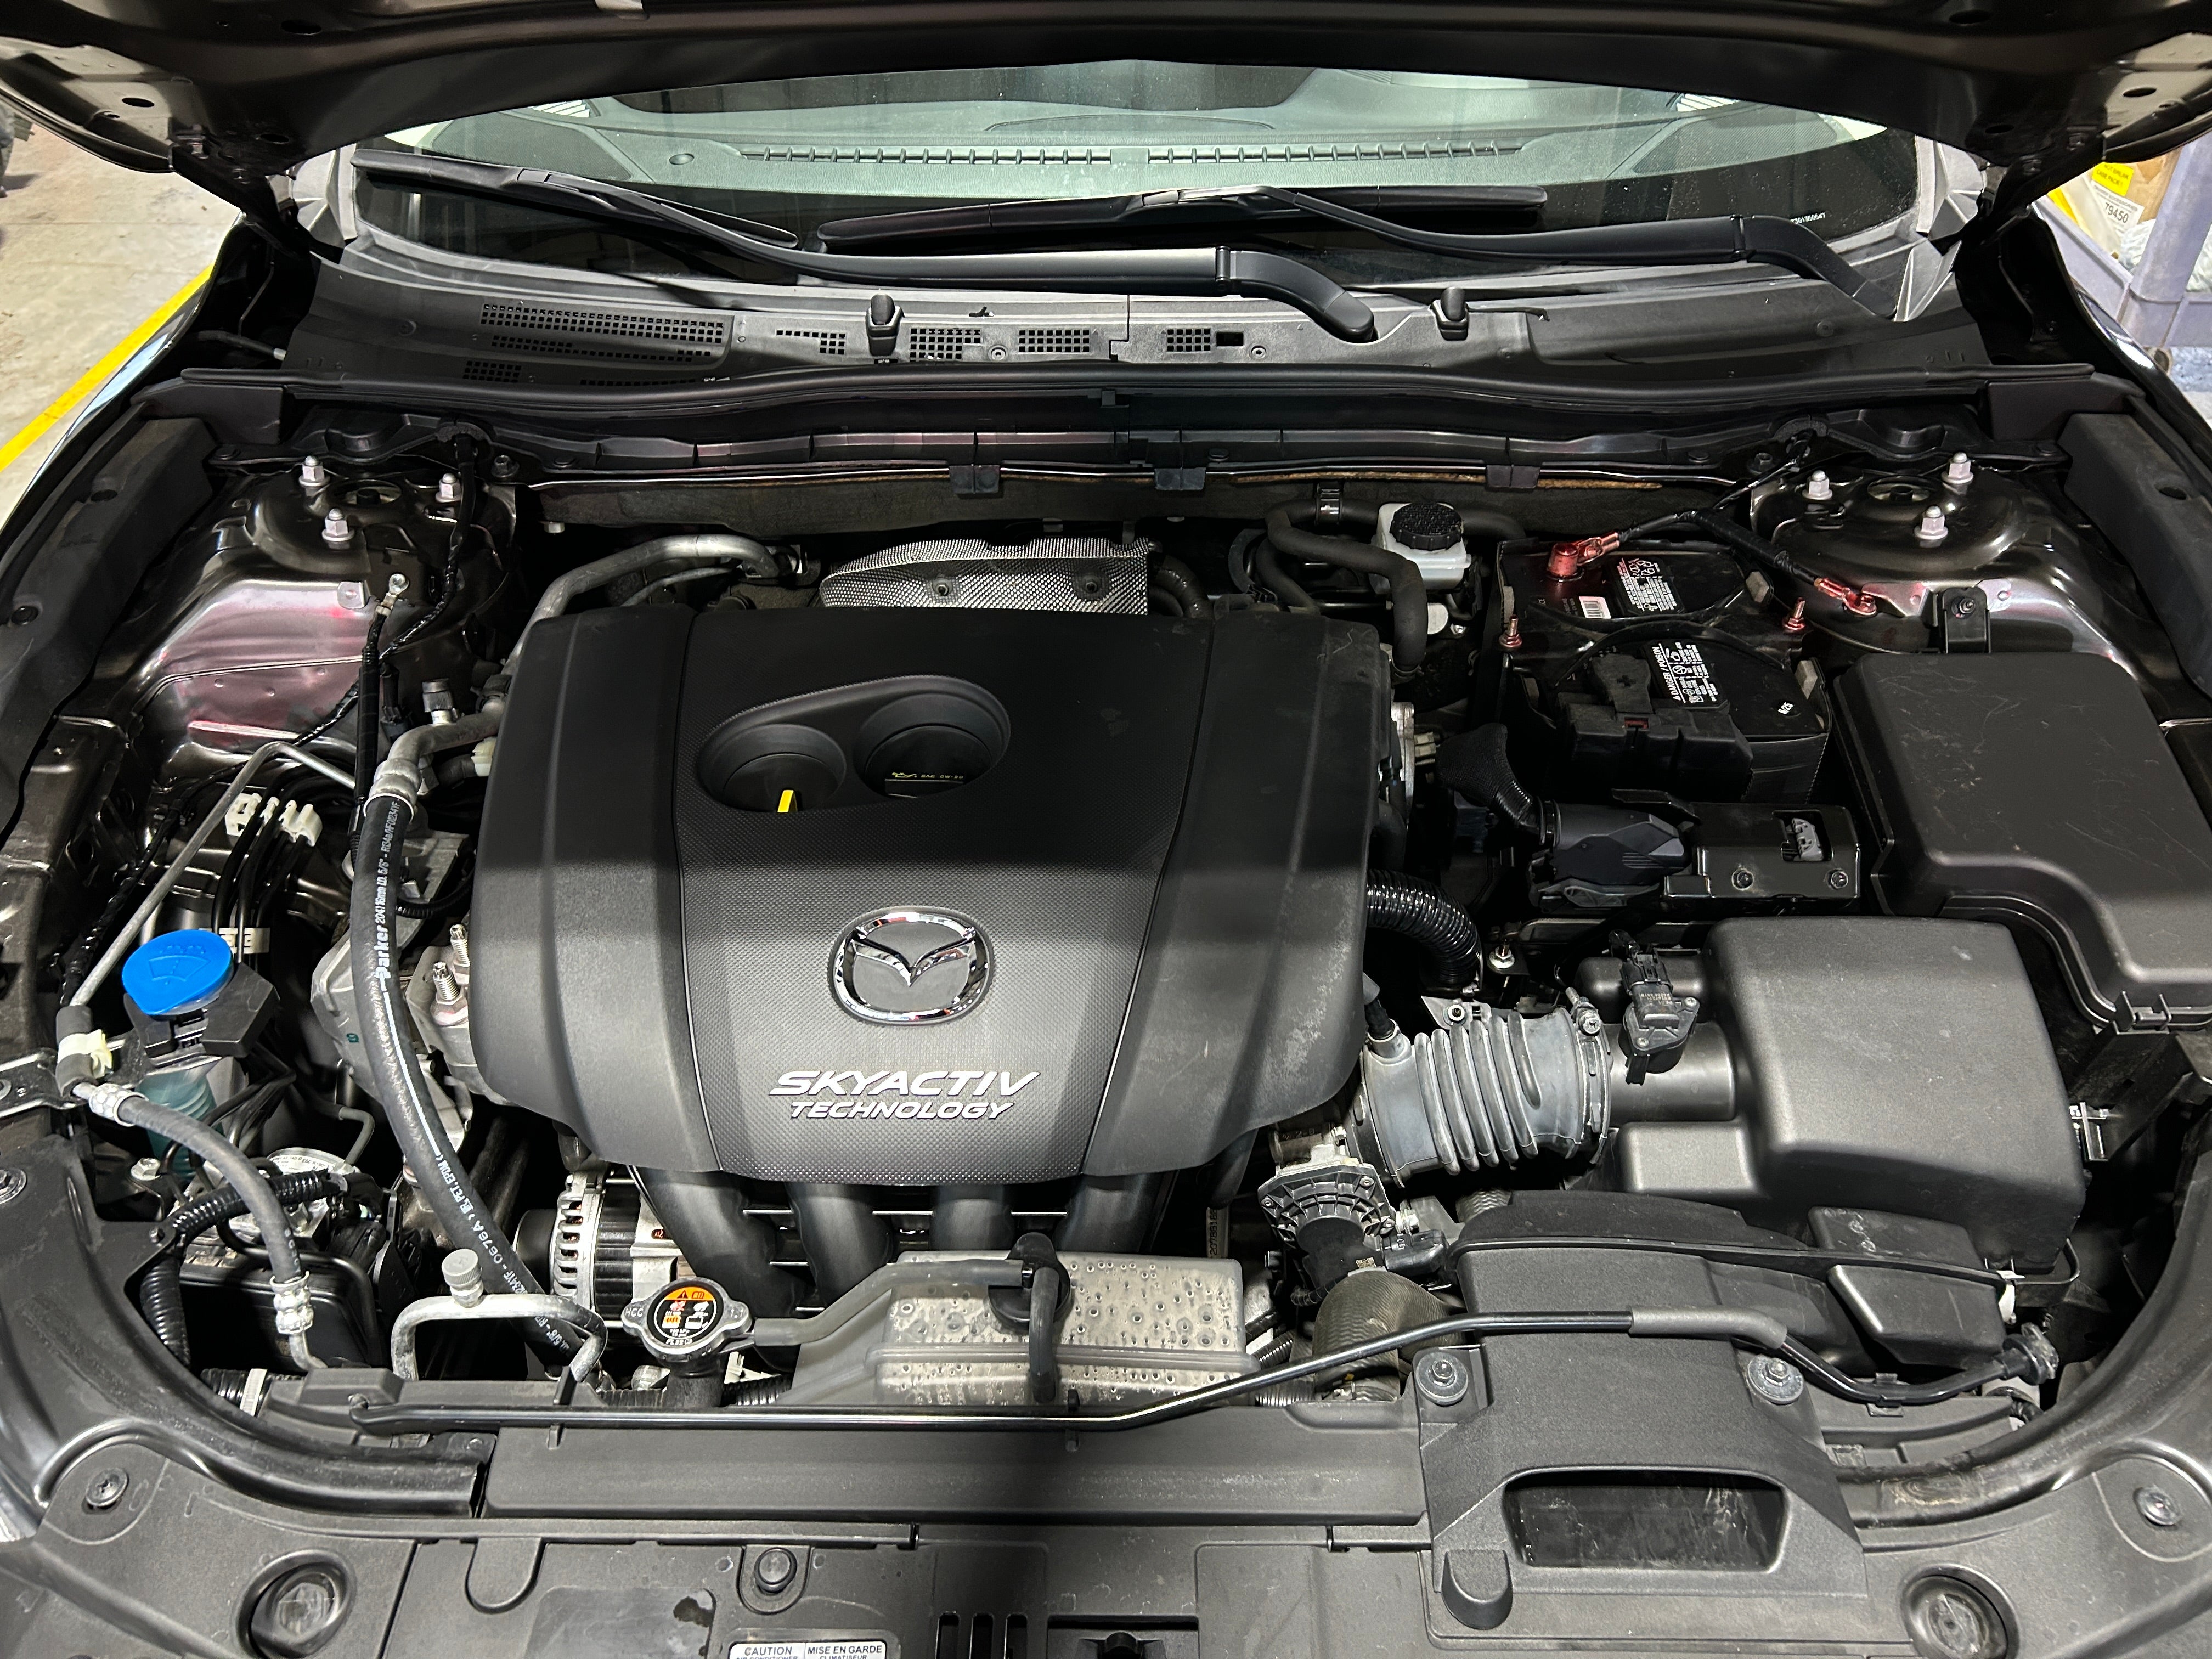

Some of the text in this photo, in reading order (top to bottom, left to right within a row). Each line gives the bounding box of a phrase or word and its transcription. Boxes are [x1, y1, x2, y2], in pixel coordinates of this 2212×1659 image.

[2106, 202, 2129, 223] 79450
[1652, 647, 1667, 667] POISON
[1663, 672, 1679, 695] DANGER
[374, 925, 391, 978] Parker
[769, 1070, 1041, 1096] SKYACTIV
[791, 1101, 1015, 1119] TECHNOLOGY
[473, 1220, 503, 1263] 0676A
[625, 1307, 644, 1317] HCC
[744, 1645, 882, 1656] CAUTION MISE EN GARDE
